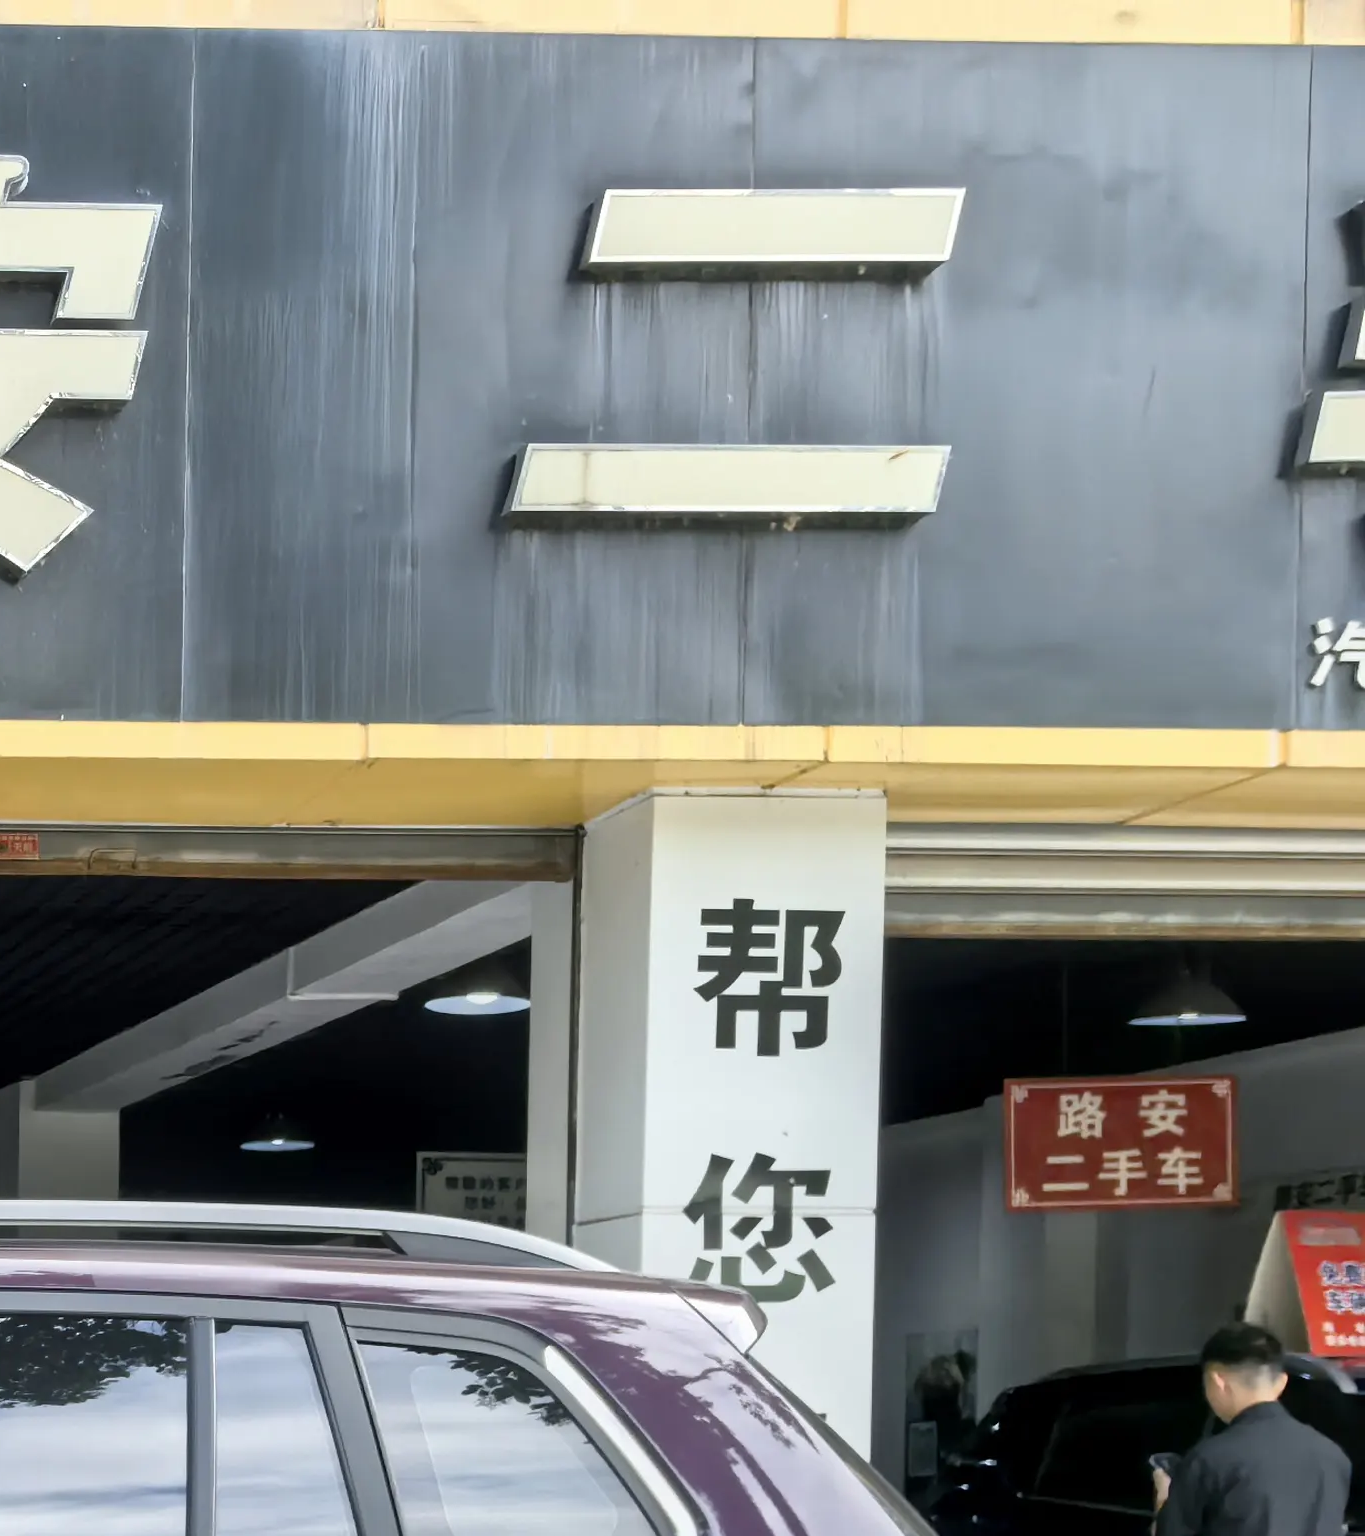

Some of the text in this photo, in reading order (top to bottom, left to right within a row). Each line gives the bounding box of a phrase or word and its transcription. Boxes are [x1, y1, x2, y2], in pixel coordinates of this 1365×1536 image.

[1057, 1089, 1188, 1139] 路安
[1042, 1147, 1204, 1197] 二手车
